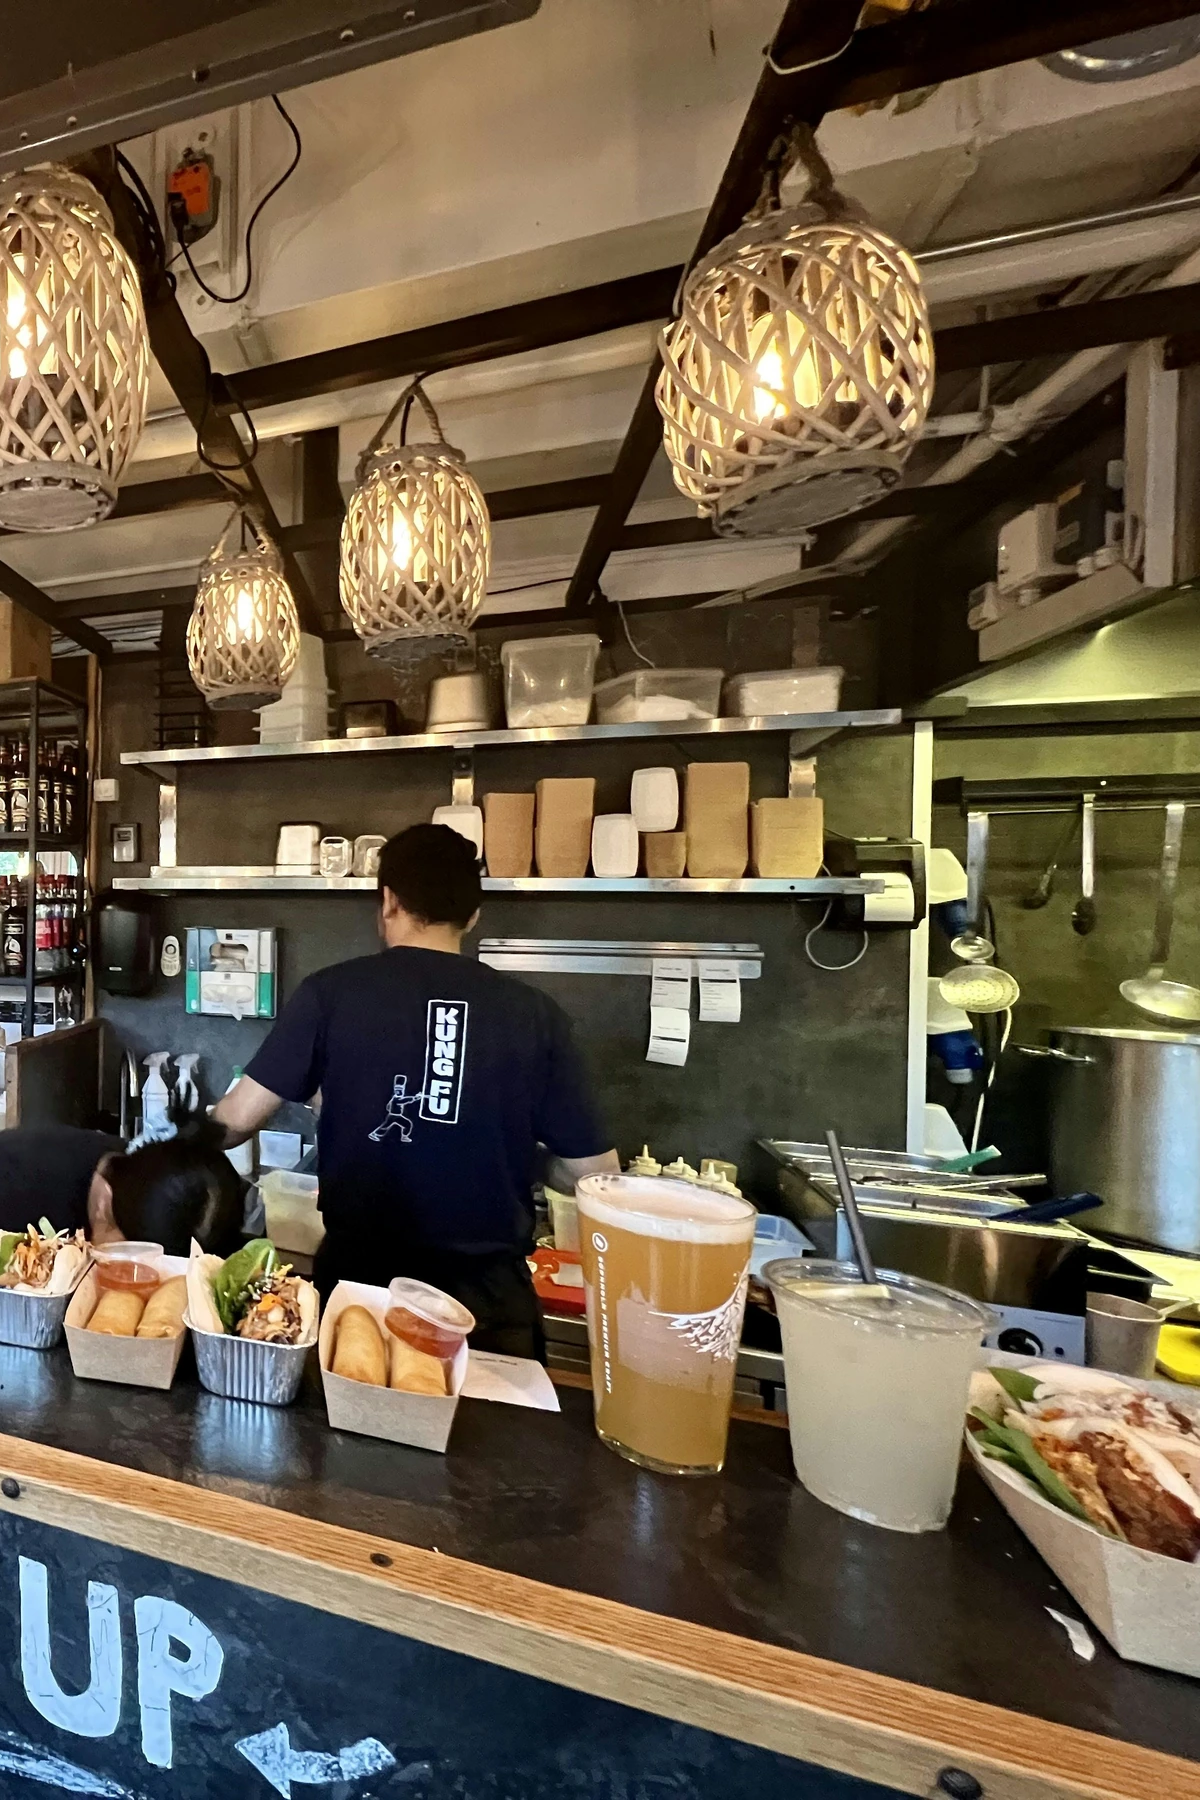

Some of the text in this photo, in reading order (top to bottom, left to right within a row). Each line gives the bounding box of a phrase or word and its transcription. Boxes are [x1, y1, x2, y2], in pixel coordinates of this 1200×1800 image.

[429, 1007, 460, 1115] KUNG FU
[600, 1312, 610, 1359] PREMIUM
[18, 1555, 225, 1769] UP
